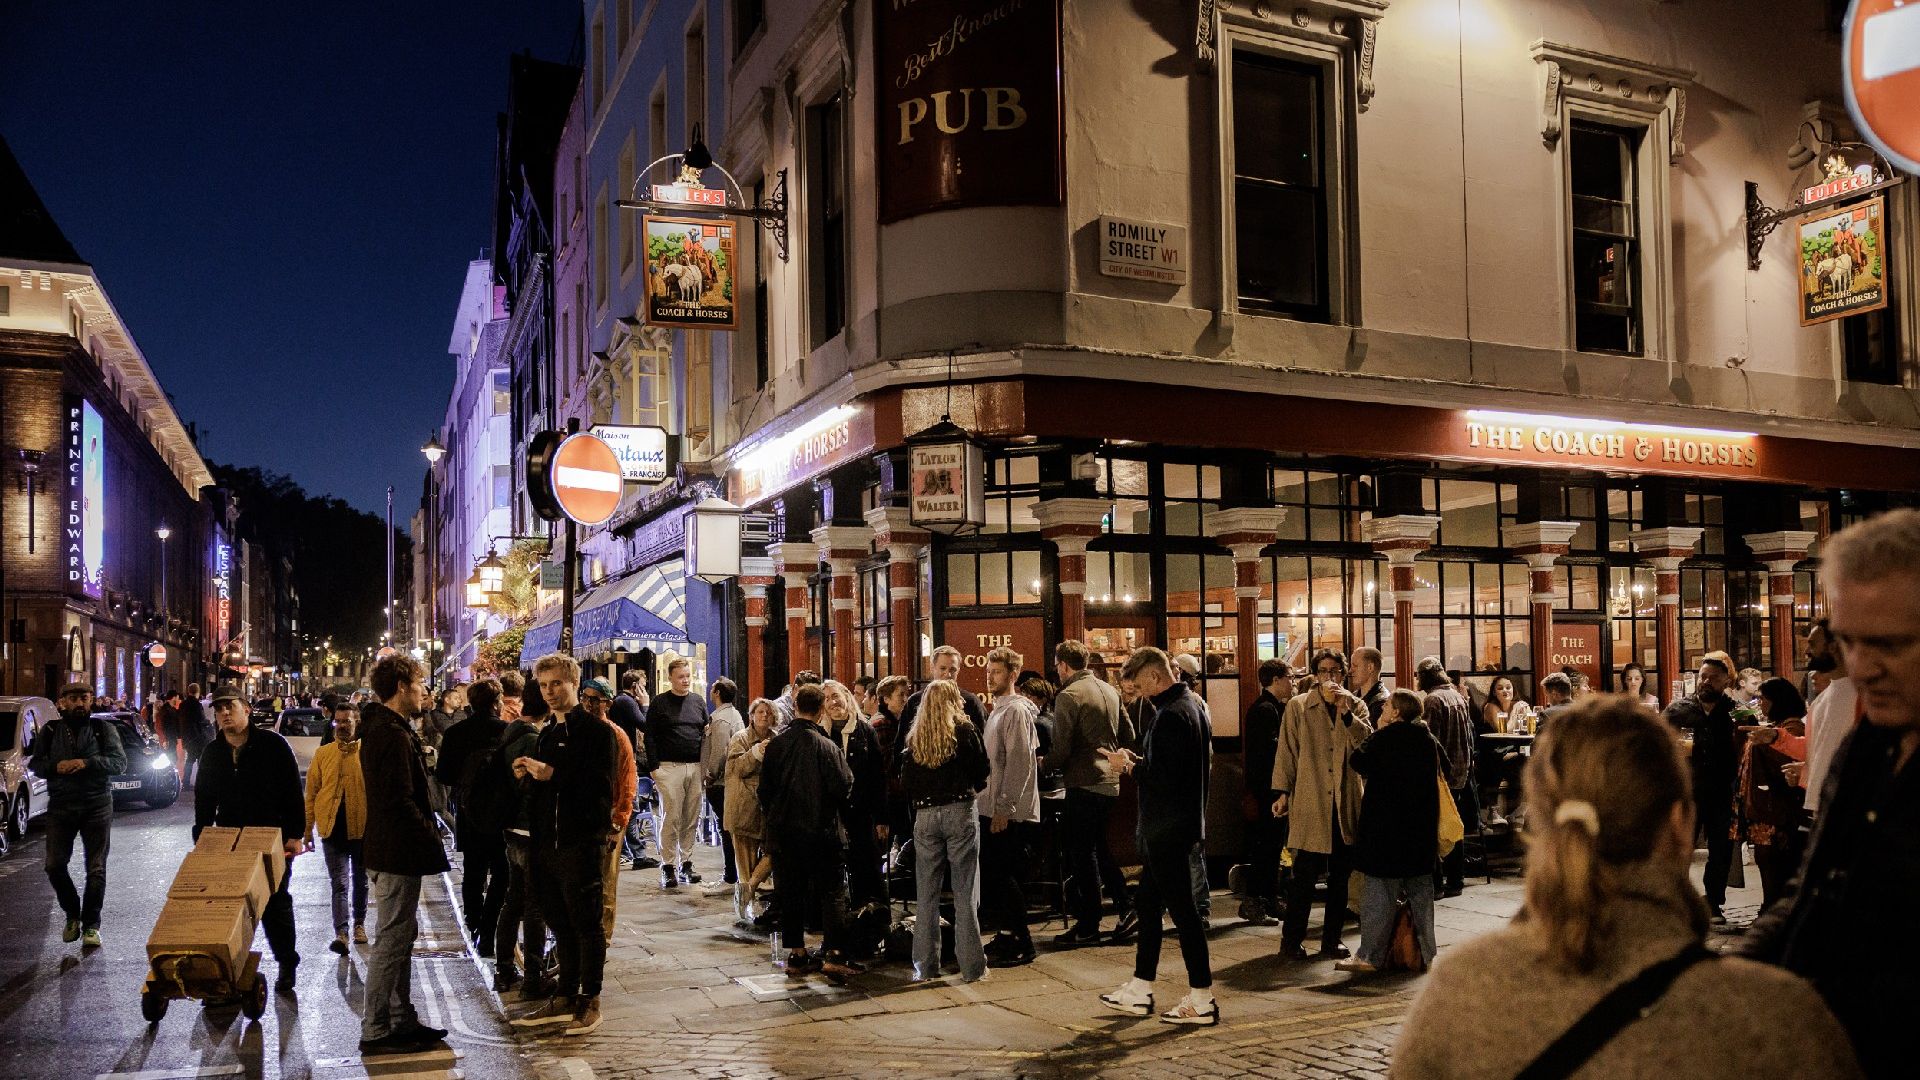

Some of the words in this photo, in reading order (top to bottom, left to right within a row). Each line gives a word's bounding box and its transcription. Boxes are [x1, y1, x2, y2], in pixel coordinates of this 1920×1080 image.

[895, 35, 946, 89] Best
[897, 87, 1027, 146] PUB
[1108, 221, 1167, 243] ROMILLY
[1109, 240, 1157, 260] STREET
[1161, 247, 1178, 264] W1
[1109, 264, 1123, 273] CITY
[1125, 266, 1132, 275] OF
[1133, 268, 1175, 280] WESTMINSTER
[1810, 301, 1837, 314] COACH
[1838, 299, 1845, 307] &
[1846, 290, 1878, 306] HORSES
[1832, 289, 1852, 300] THE
[657, 307, 685, 317] COACH
[687, 309, 694, 317] &
[695, 309, 728, 319] HORSES
[685, 301, 701, 309] THE
[596, 428, 630, 440] Maison
[69, 408, 81, 487] PRINCE
[804, 421, 849, 465] HORSES
[1465, 422, 1523, 451] THE
[1533, 427, 1625, 458] COACH
[1634, 436, 1653, 461] &
[1662, 437, 1759, 468] HORSES
[917, 452, 956, 466] TAYLOR
[917, 500, 960, 513] WALKER
[67, 500, 82, 581] EDWARD
[976, 634, 1012, 648] THE
[1560, 636, 1585, 648] THE
[1552, 653, 1593, 665] COACH
